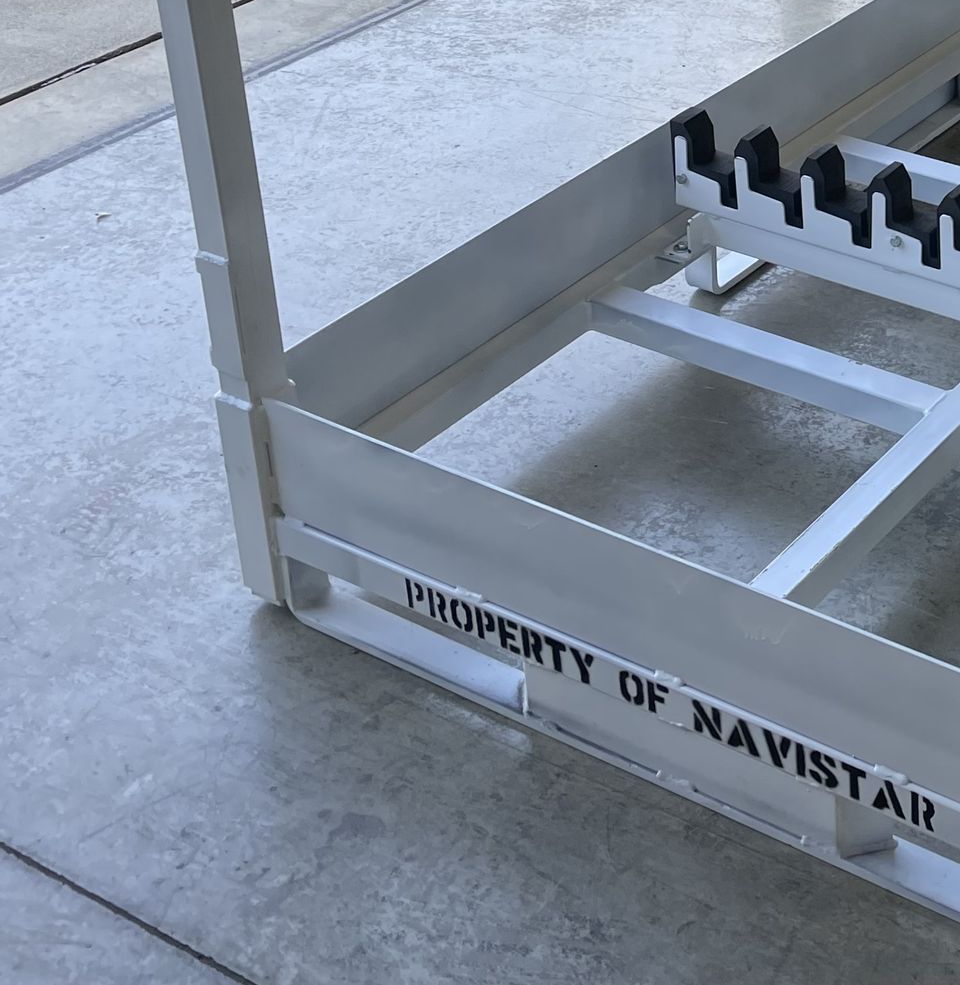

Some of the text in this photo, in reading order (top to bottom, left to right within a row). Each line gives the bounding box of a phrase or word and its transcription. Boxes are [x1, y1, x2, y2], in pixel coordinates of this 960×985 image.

[404, 577, 936, 833] PROPERTY OF NAVISTAR
